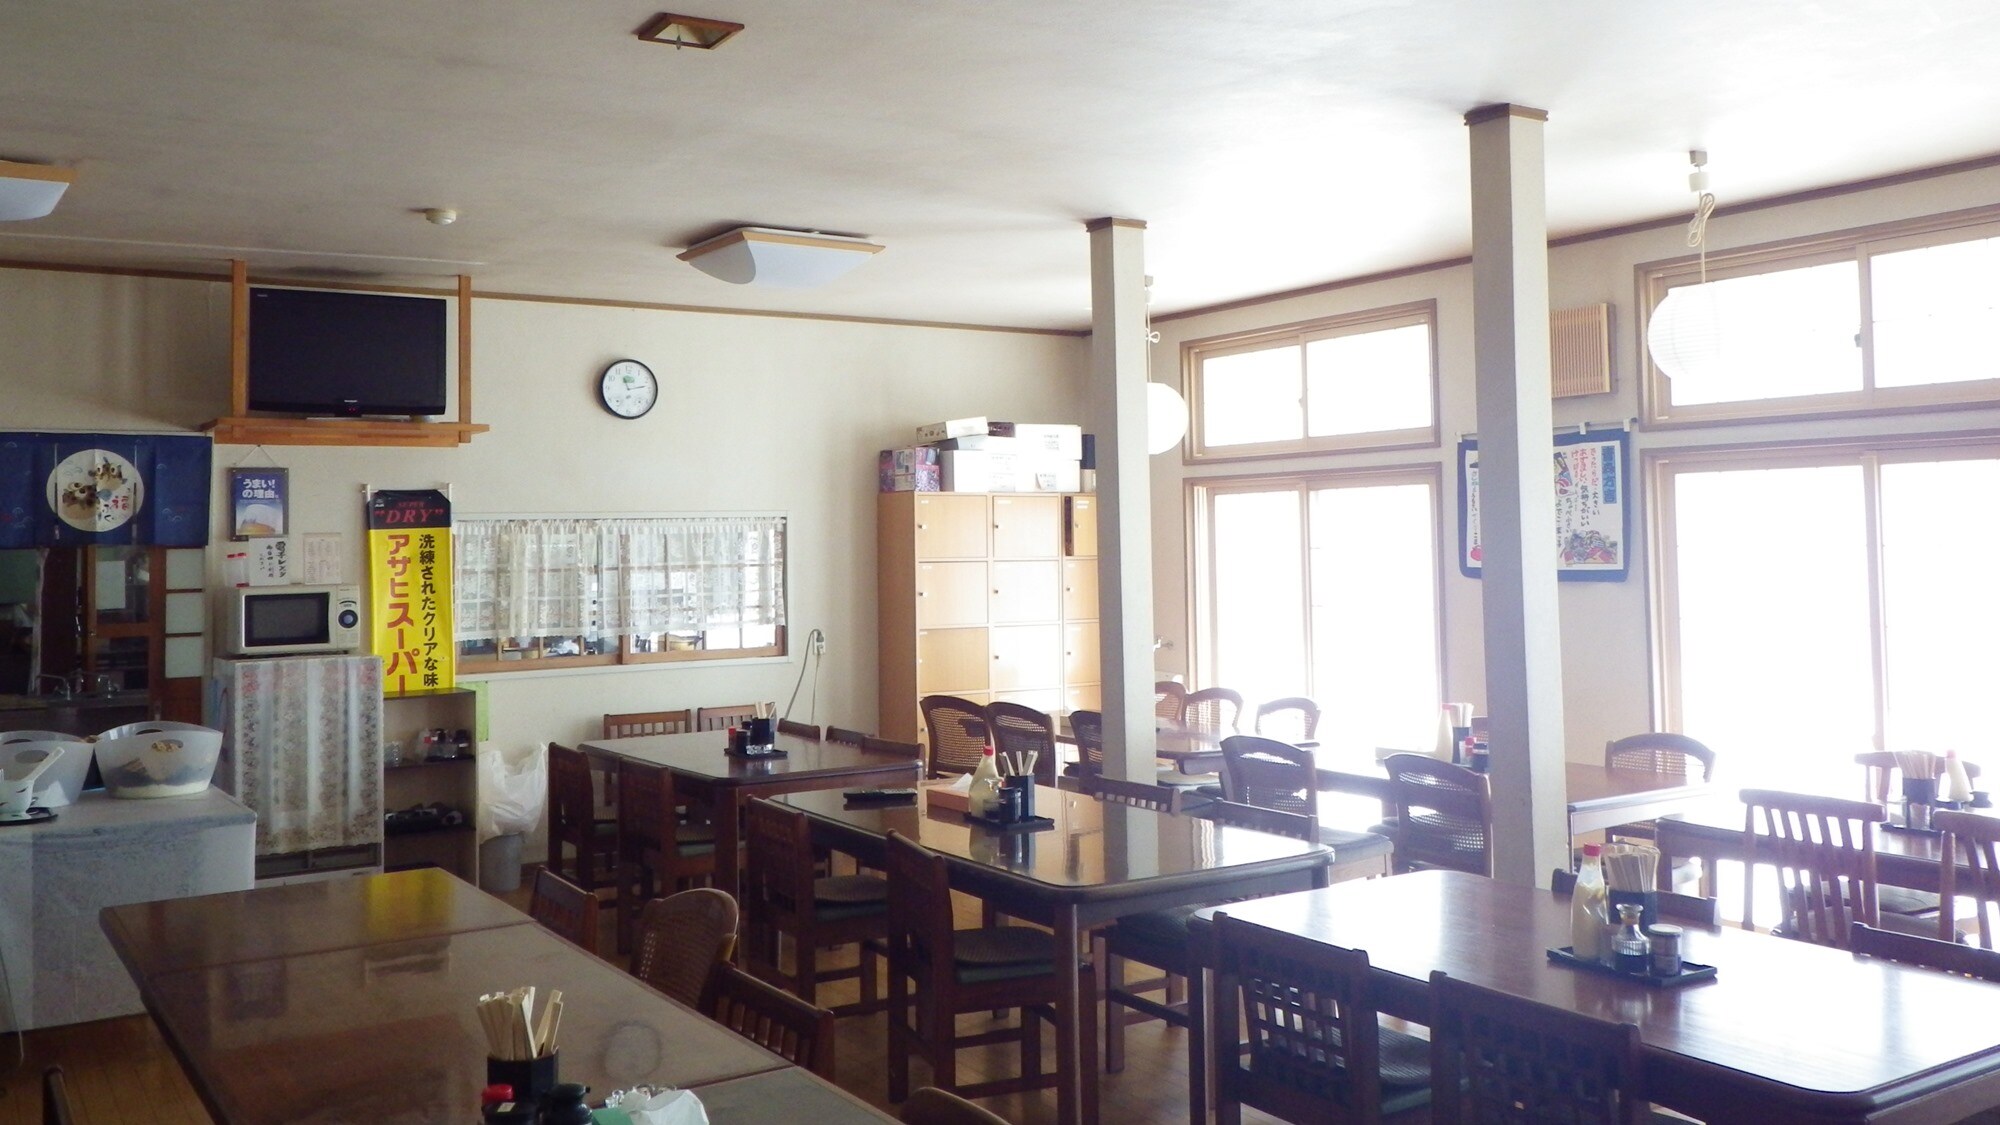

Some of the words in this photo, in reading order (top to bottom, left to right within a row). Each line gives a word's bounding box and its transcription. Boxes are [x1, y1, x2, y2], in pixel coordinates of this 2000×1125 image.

[386, 534, 420, 697] アサヒスーパー
